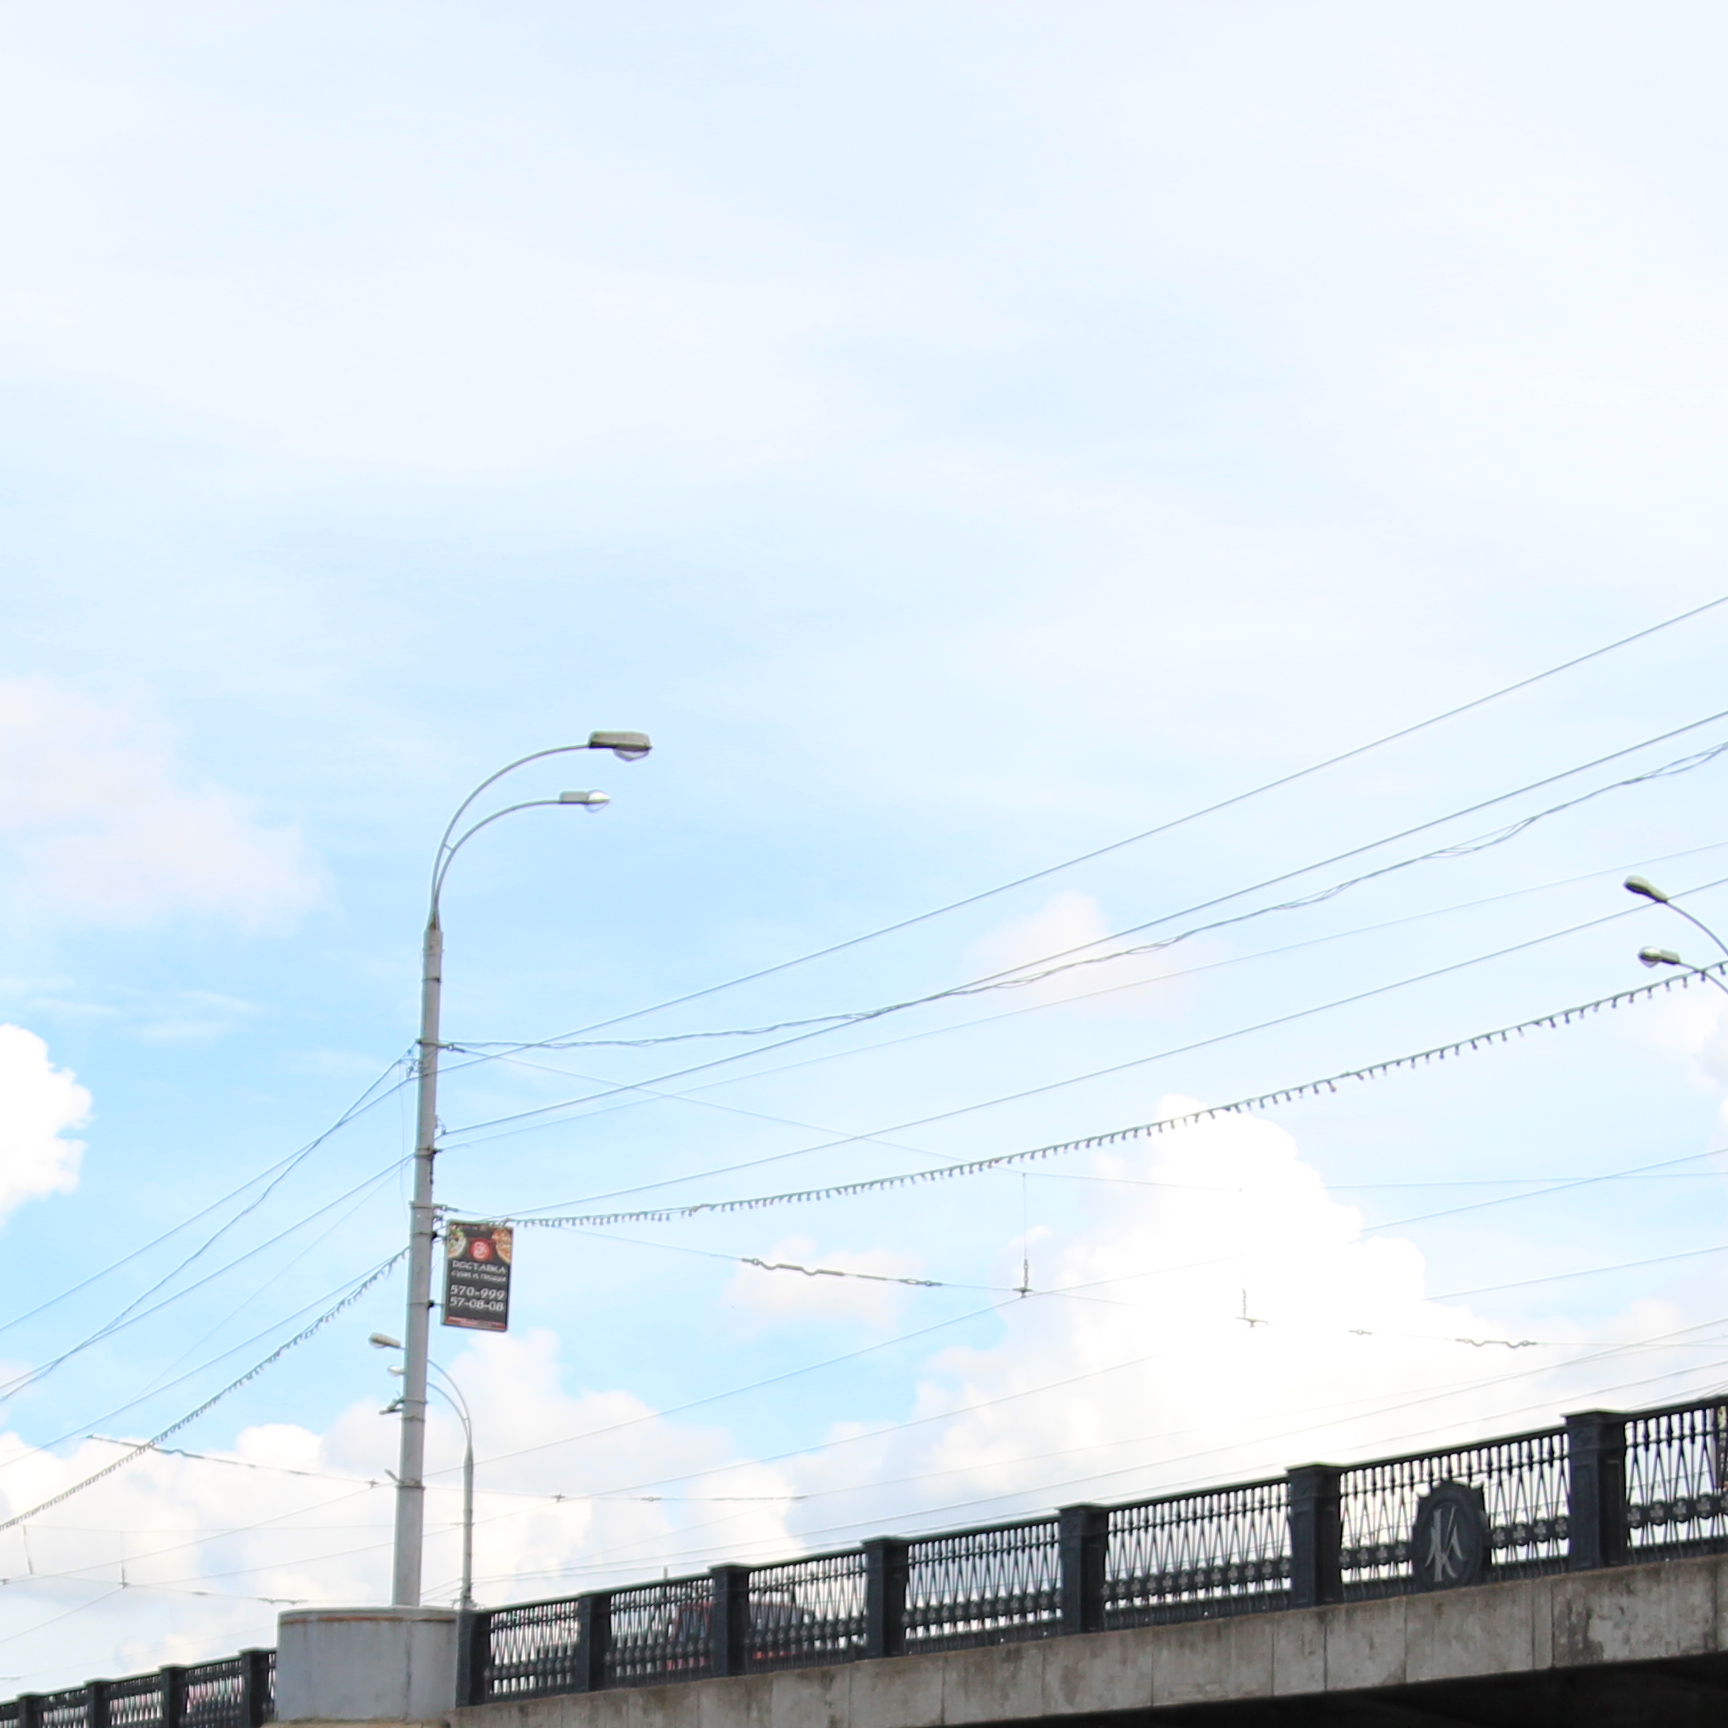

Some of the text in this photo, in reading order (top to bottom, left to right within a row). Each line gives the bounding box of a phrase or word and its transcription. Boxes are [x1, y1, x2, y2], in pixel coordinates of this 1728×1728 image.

[452, 1260, 506, 1274] ДОСТАВКА
[450, 1284, 505, 1300] 570-999
[449, 1296, 504, 1311] 57-08-08
